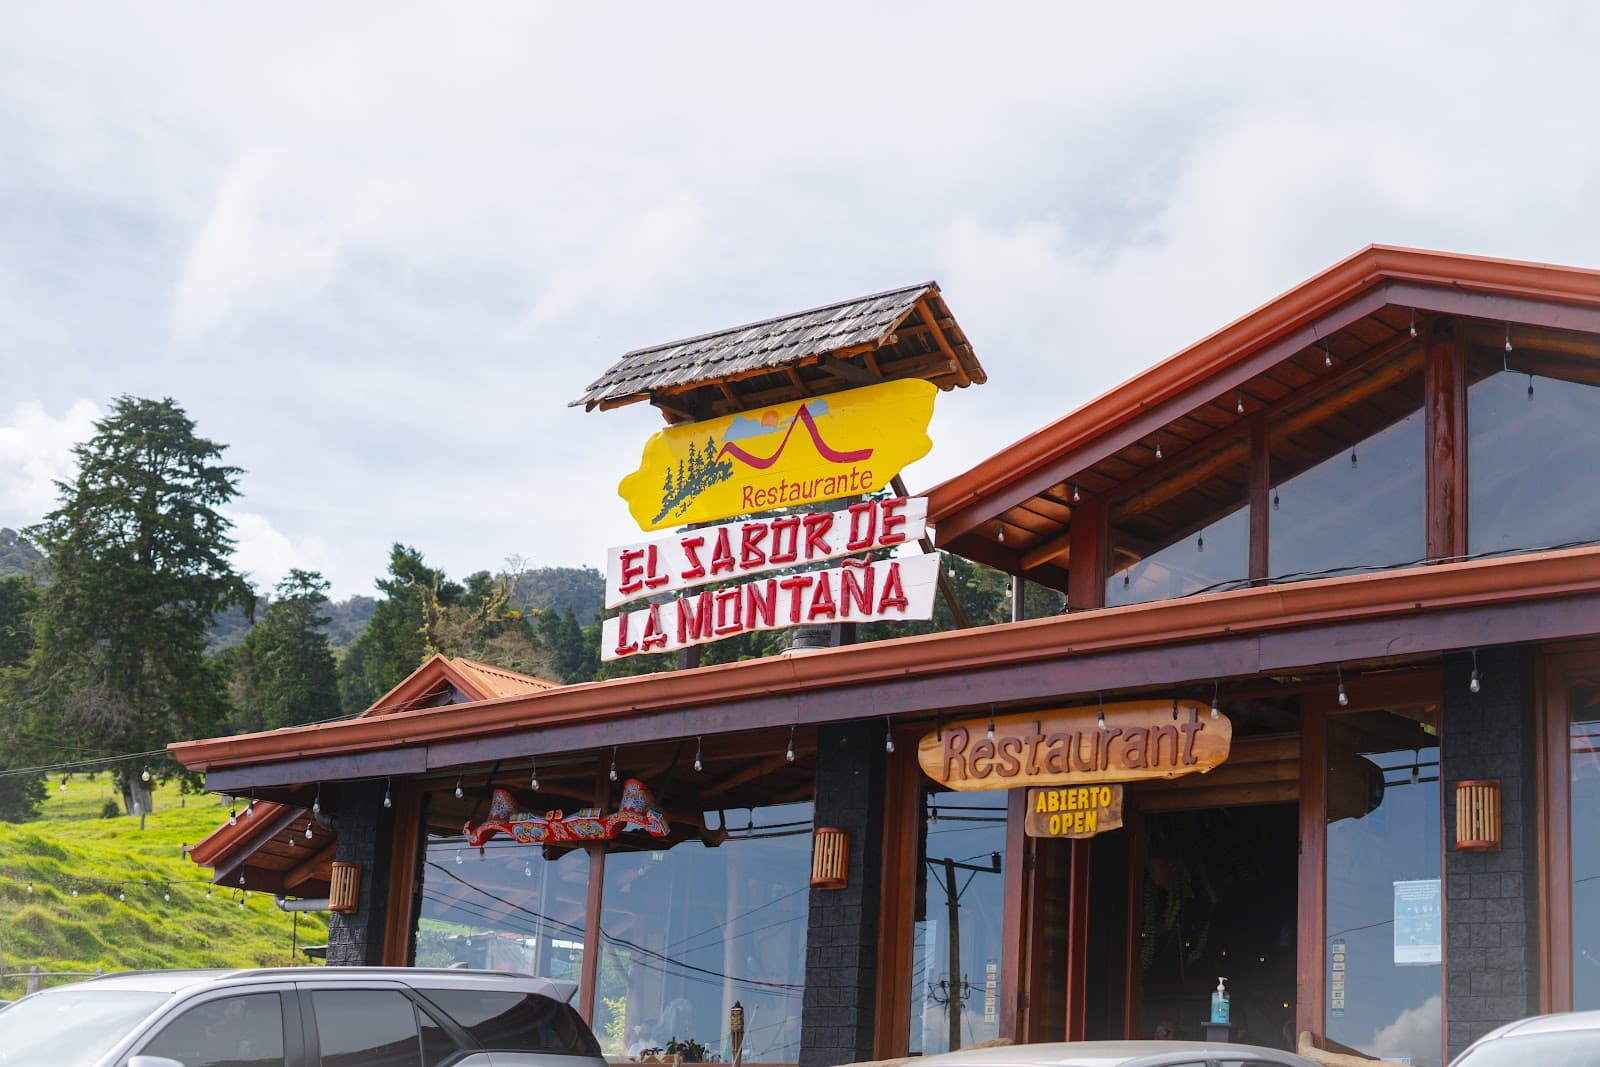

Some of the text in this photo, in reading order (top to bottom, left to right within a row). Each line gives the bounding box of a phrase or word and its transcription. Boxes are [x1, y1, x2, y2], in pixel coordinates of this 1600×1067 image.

[742, 466, 874, 509] Restaurante
[618, 495, 908, 594] EL SABOR DE
[614, 552, 909, 656] LA MONTAÑA
[942, 706, 1205, 781] Restaurant
[1036, 786, 1112, 814] ABIERTO
[1049, 810, 1098, 836] OPEN
